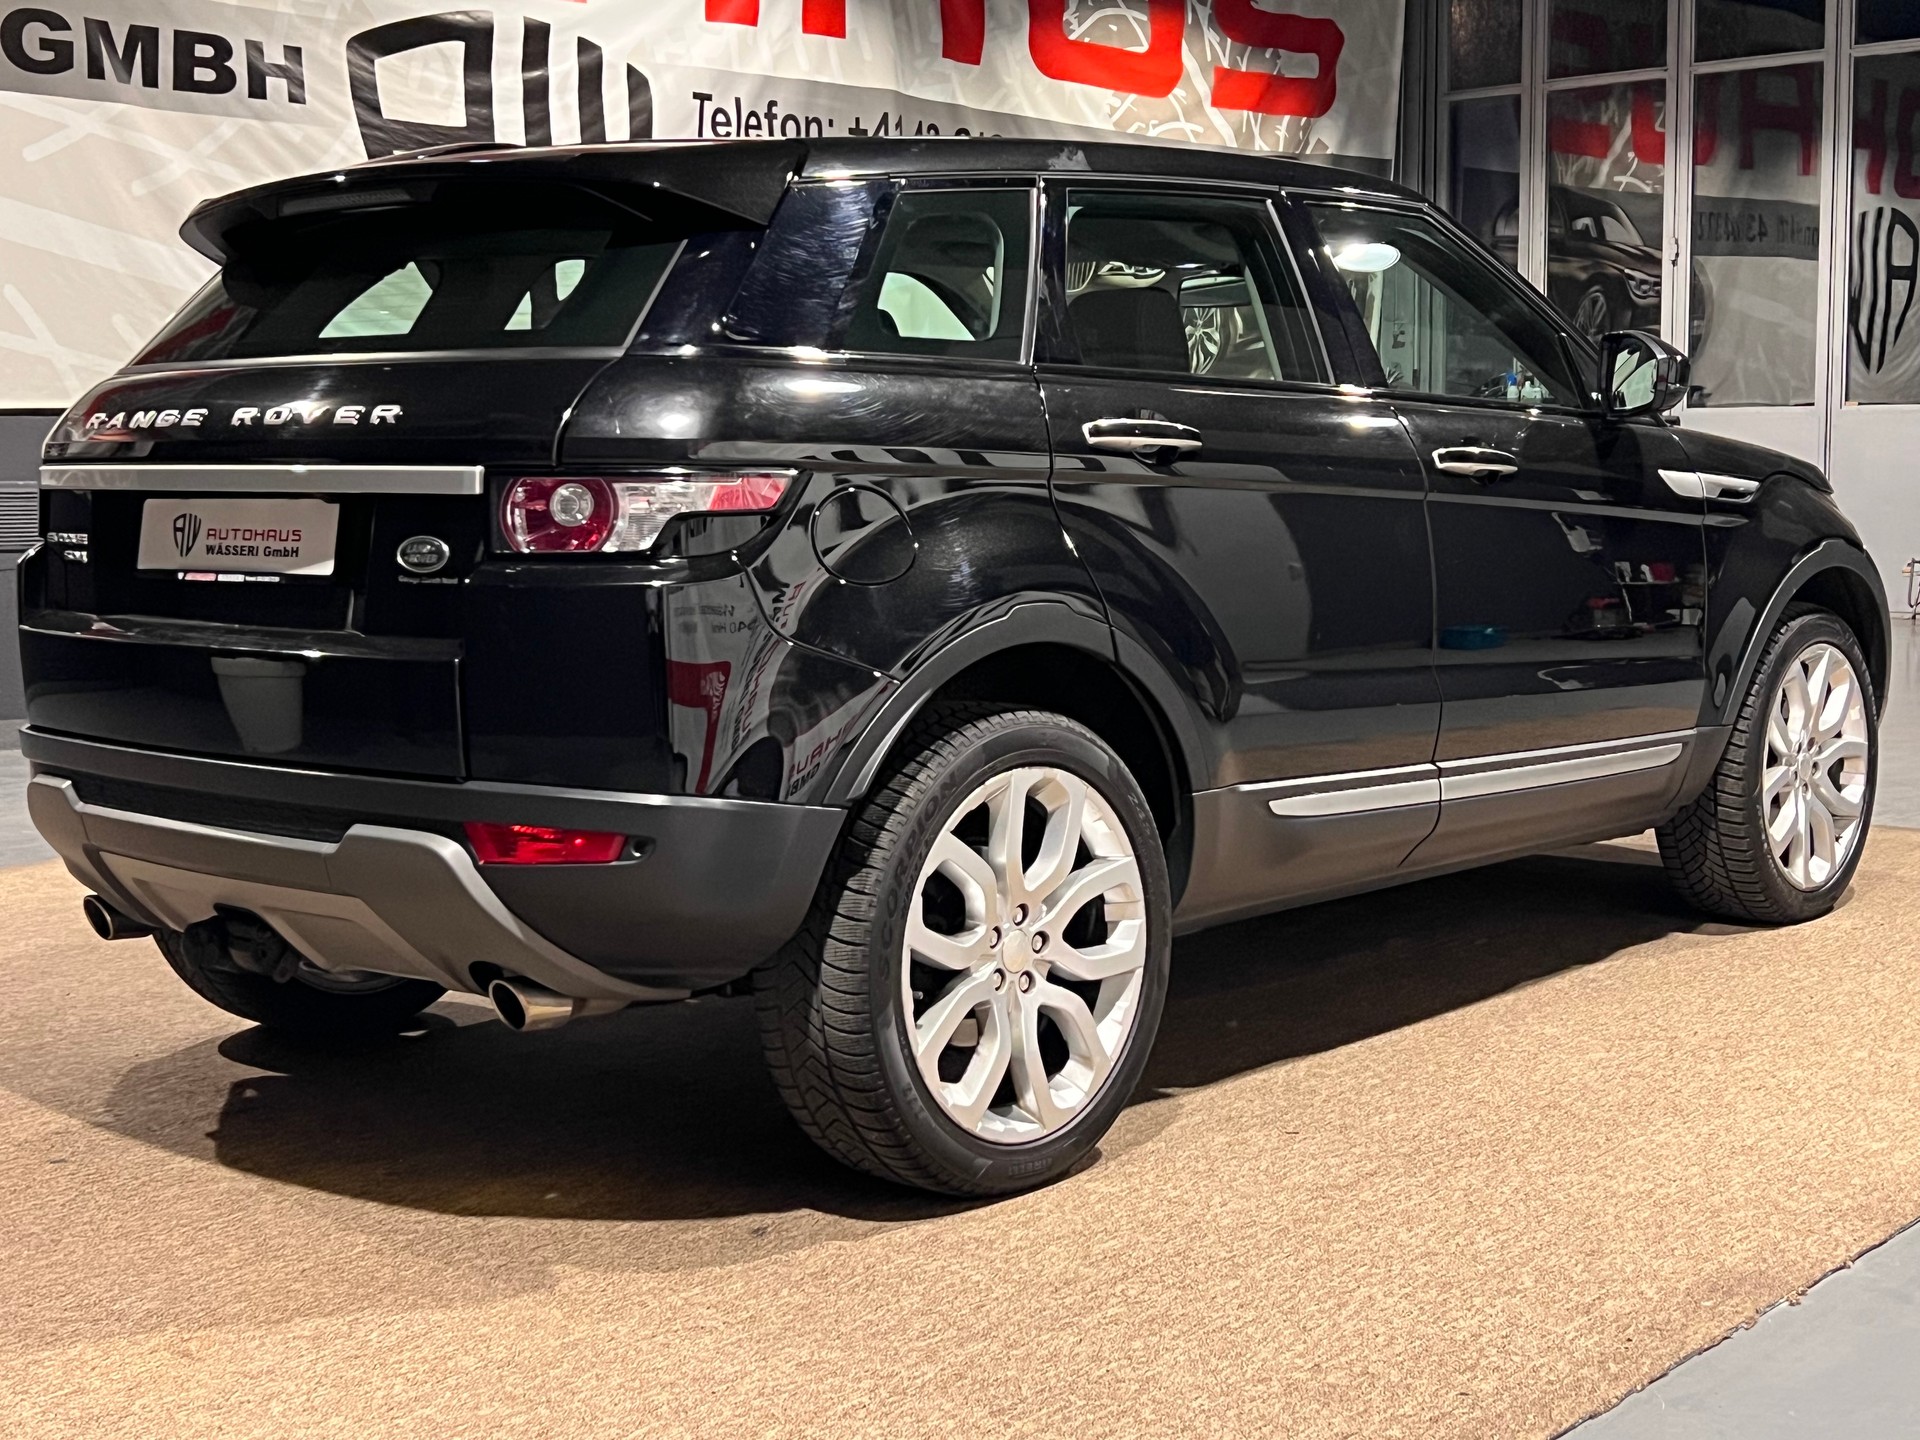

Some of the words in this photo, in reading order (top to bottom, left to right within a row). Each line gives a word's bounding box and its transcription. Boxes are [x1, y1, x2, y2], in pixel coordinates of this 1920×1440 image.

[0, 7, 307, 105] GMBH
[86, 408, 208, 430] RANGE
[230, 404, 403, 427] ROVER
[206, 528, 302, 542] AUTOHAUS
[263, 545, 300, 558] GmbH
